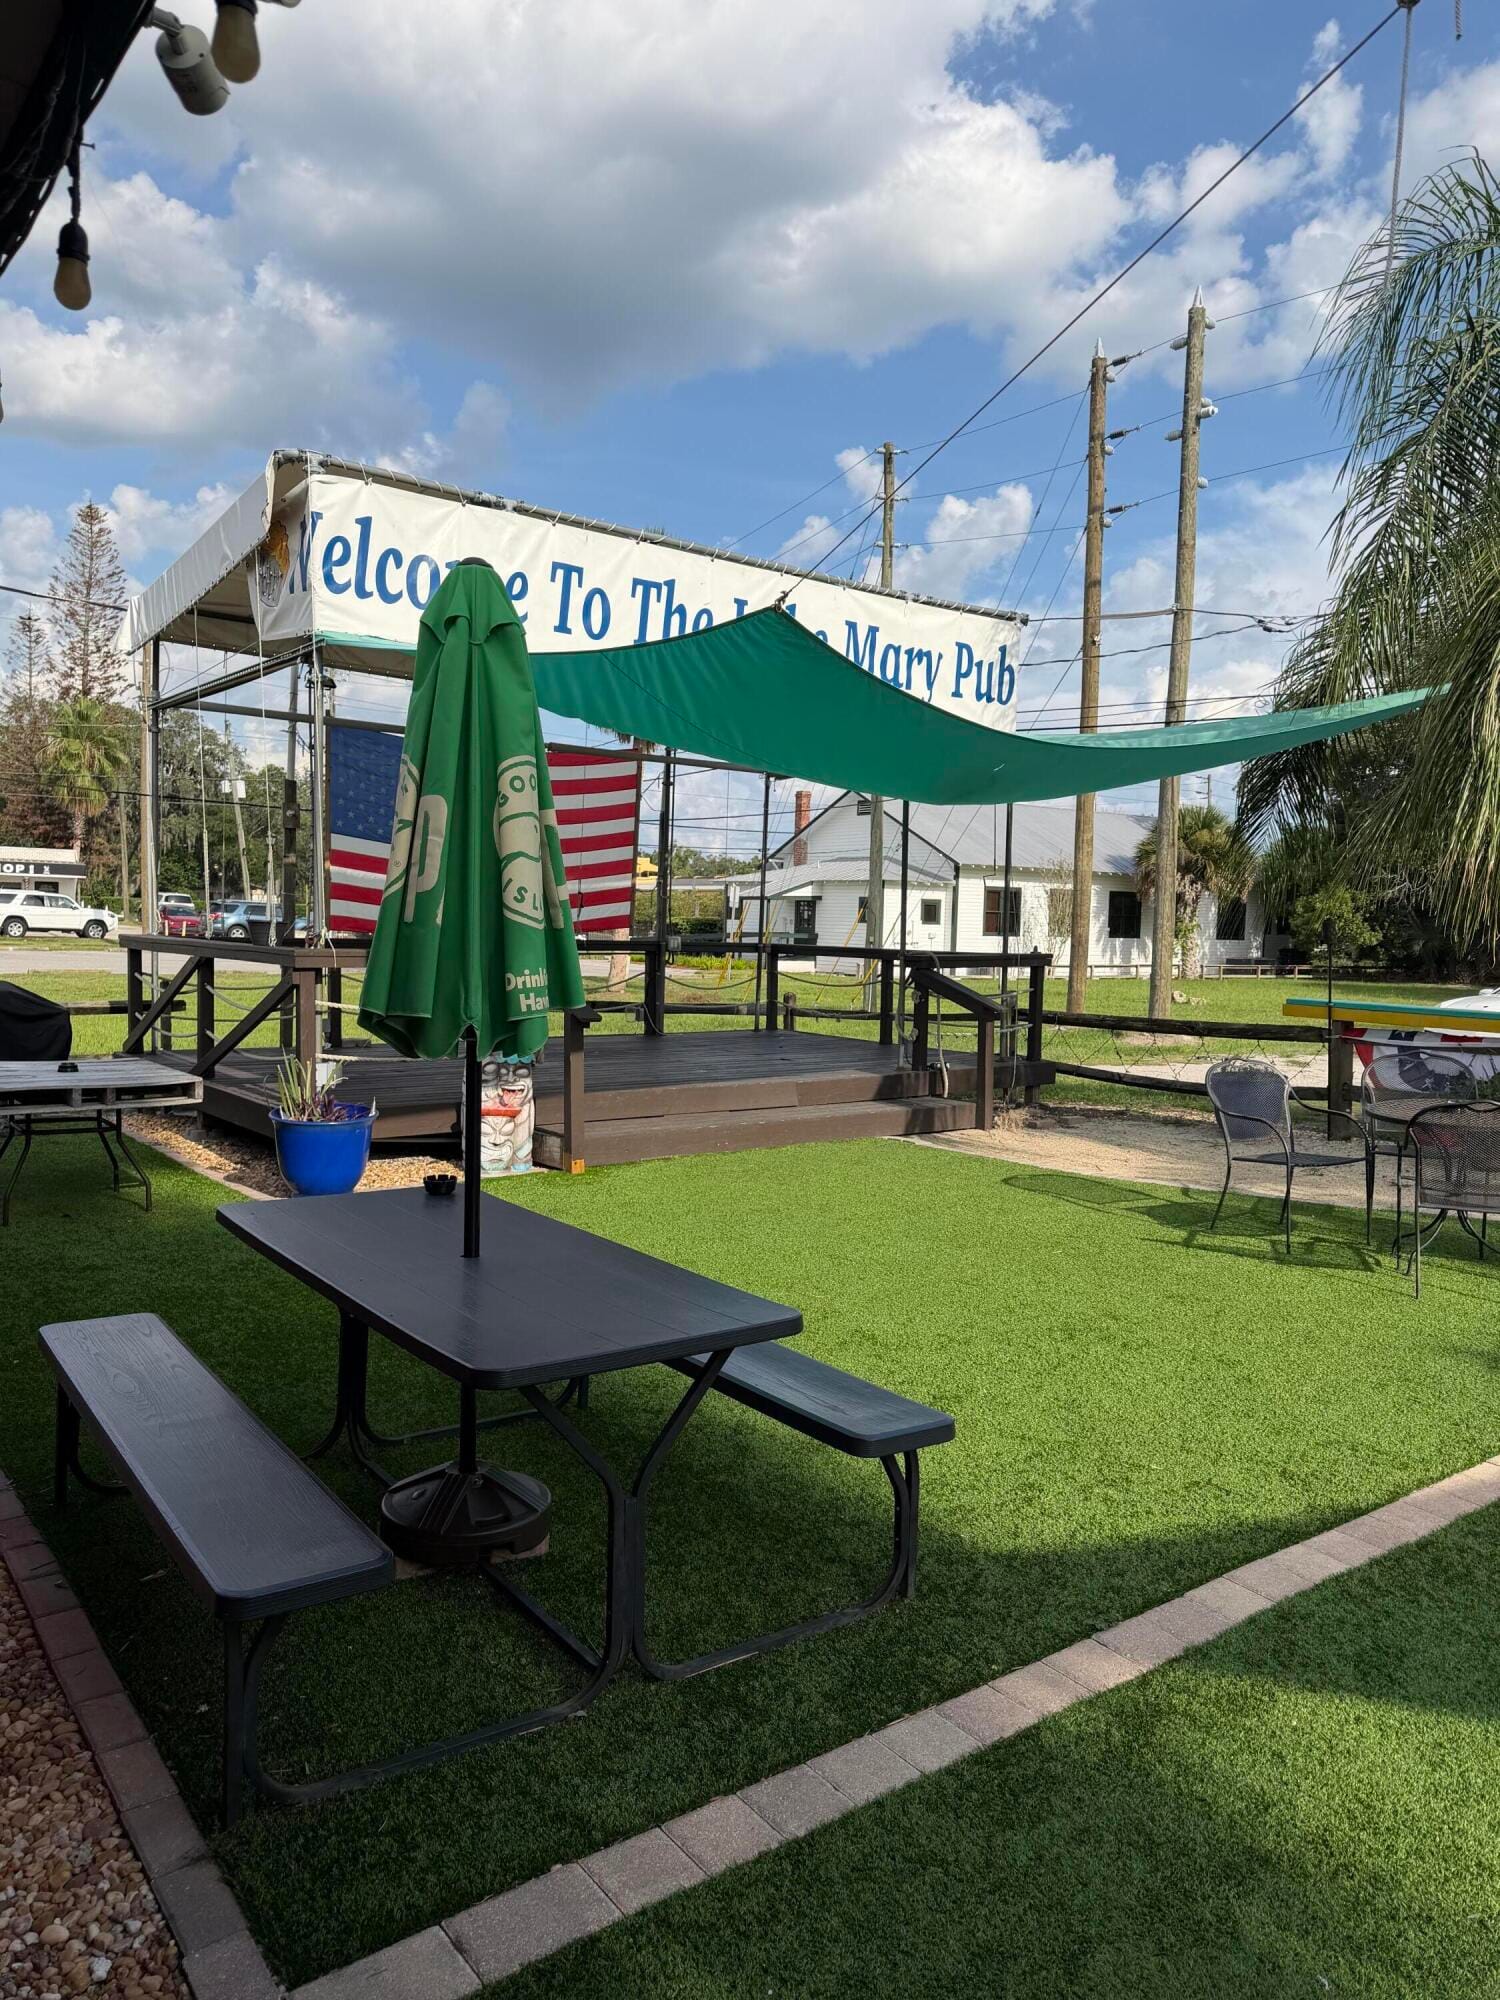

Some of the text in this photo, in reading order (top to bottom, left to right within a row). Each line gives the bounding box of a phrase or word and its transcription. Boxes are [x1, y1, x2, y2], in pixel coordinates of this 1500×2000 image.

[289, 511, 529, 623] Welcoe
[550, 561, 611, 641] To
[846, 619, 944, 702] Mary
[951, 641, 1016, 706] Pub
